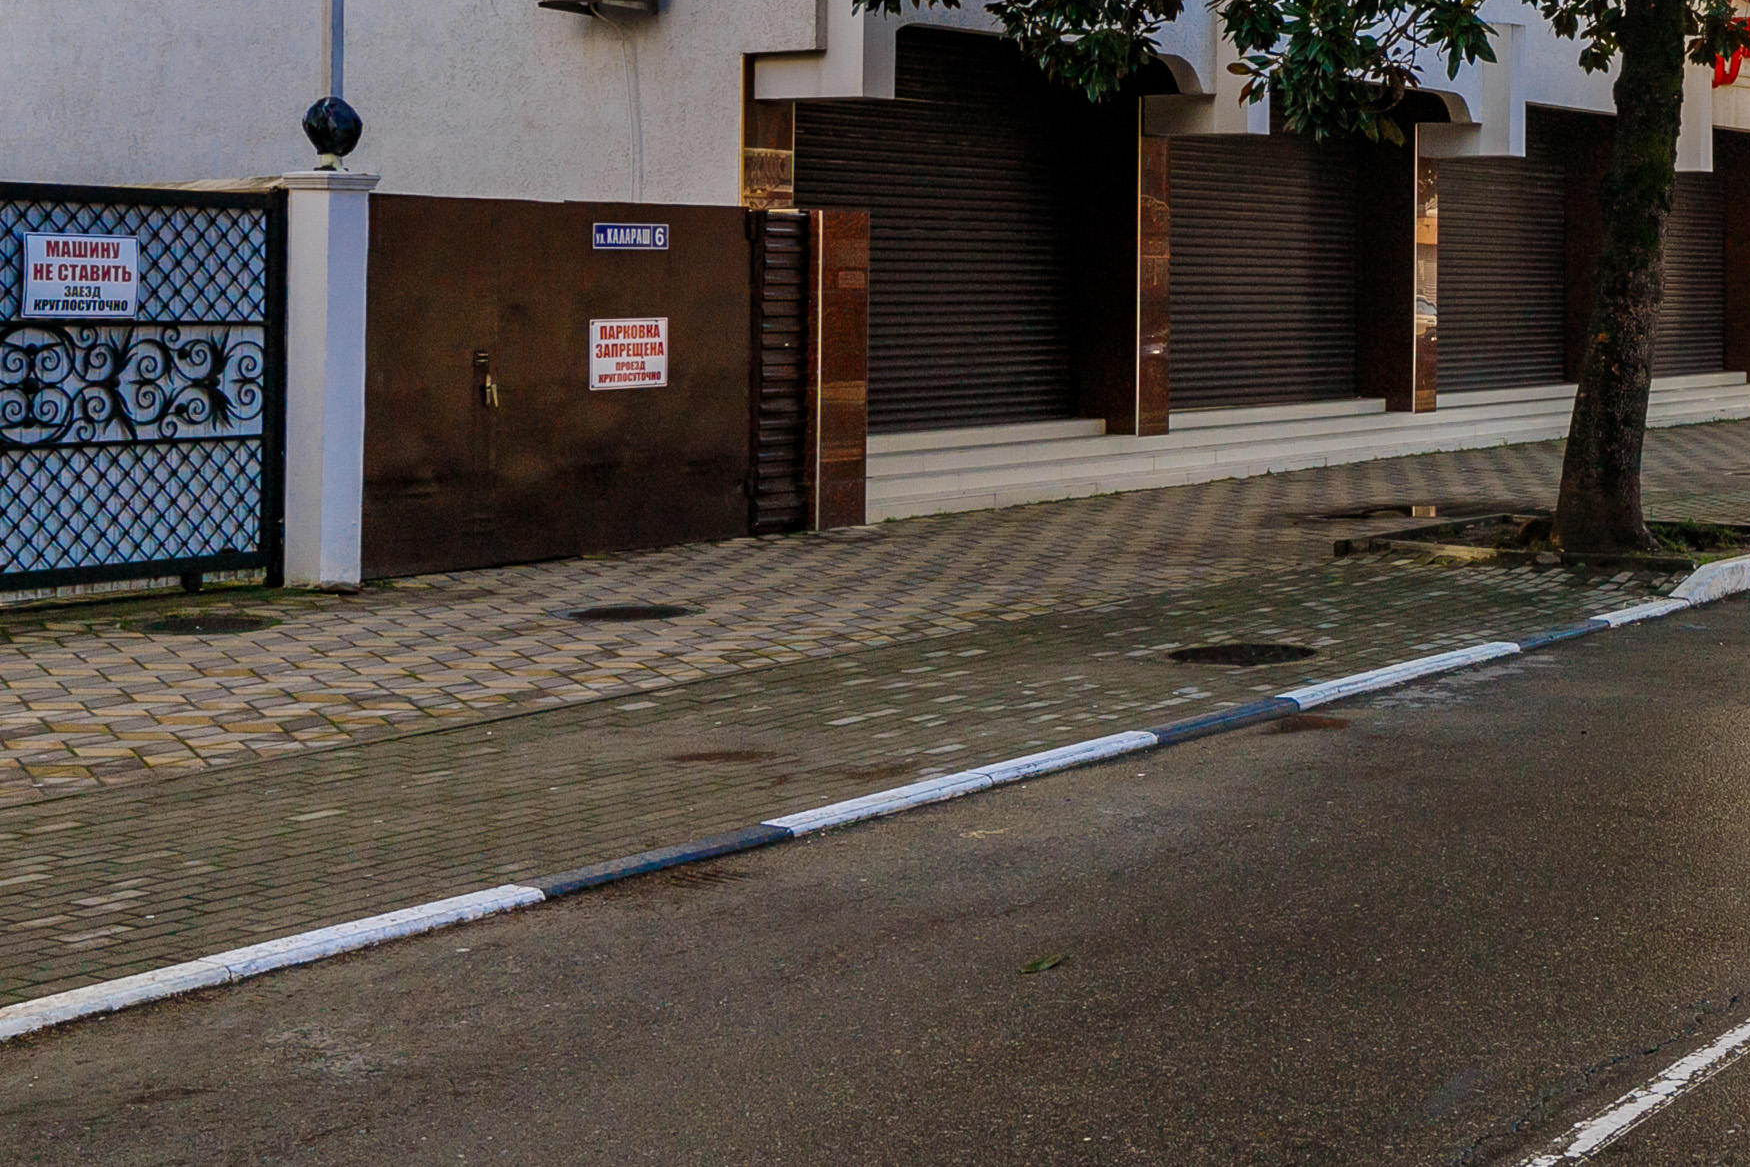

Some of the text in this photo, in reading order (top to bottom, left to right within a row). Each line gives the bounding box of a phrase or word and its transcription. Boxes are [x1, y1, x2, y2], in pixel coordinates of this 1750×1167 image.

[606, 228, 651, 245] КАЛАРАШ
[655, 227, 665, 246] 6
[45, 240, 121, 259] МАШИНУ
[33, 263, 132, 282] НЕ СТАВИТЬ
[63, 285, 101, 299] ЗАЕЗД
[33, 299, 129, 312] КРУГЛОСУТОЧНО
[599, 324, 661, 340] ПАРКОВКА
[595, 341, 665, 359] ЗАПРЕЩЕНА
[615, 361, 646, 371] ПРОЕЗД
[598, 371, 662, 384] КРУГЛОСУТОЧНО
